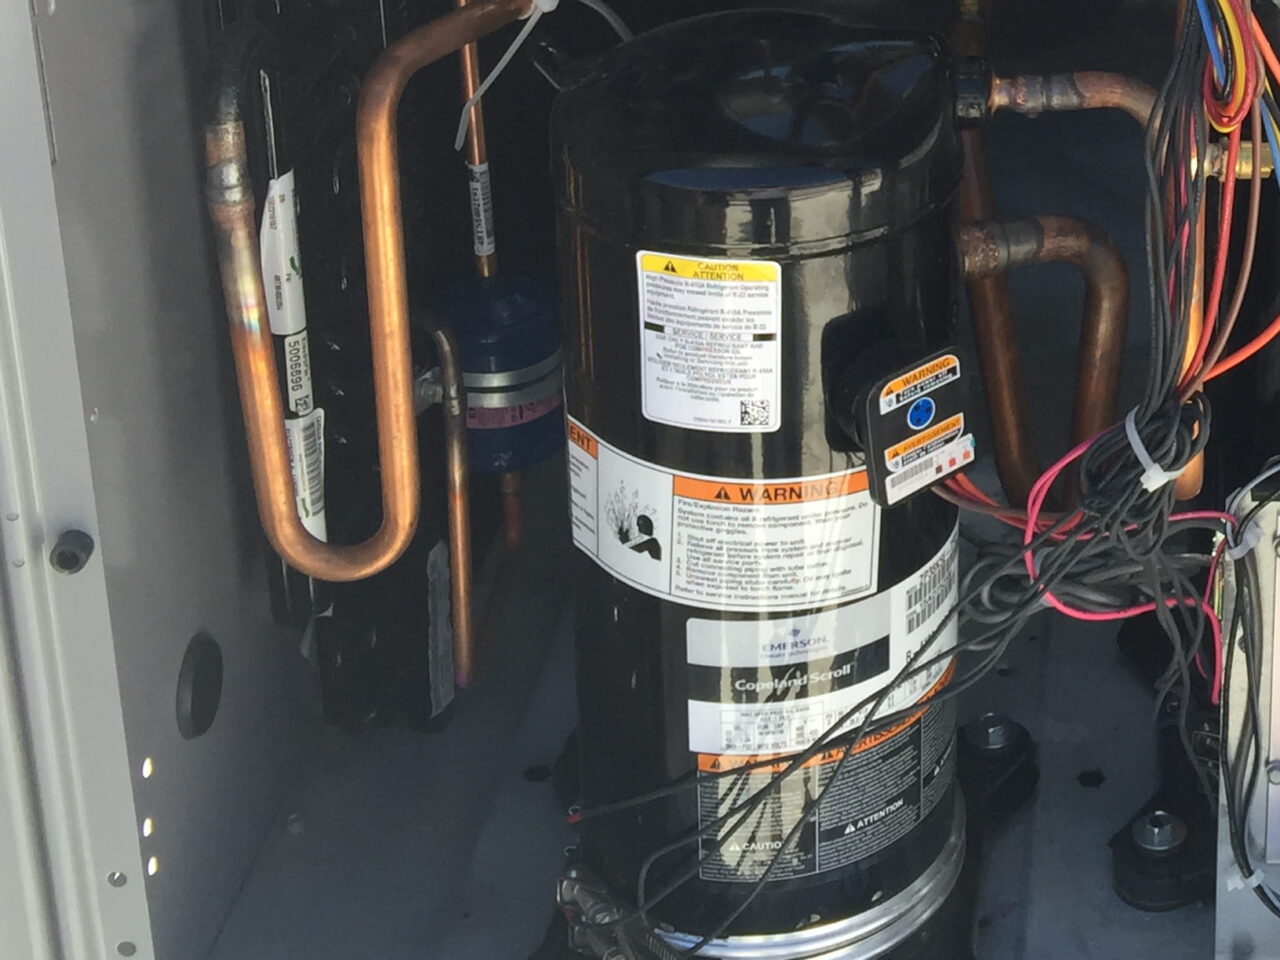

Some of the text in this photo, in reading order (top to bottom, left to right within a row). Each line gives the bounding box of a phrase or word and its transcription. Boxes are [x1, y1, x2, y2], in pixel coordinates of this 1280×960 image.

[693, 272, 744, 280] ATTENTION
[698, 263, 738, 271] CAUTION
[902, 358, 950, 387] WARNING
[739, 480, 838, 501] WARNING
[735, 664, 850, 692] Copeland Scroll
[856, 798, 904, 829] ATTENTION
[743, 841, 784, 851] CAUTIO
